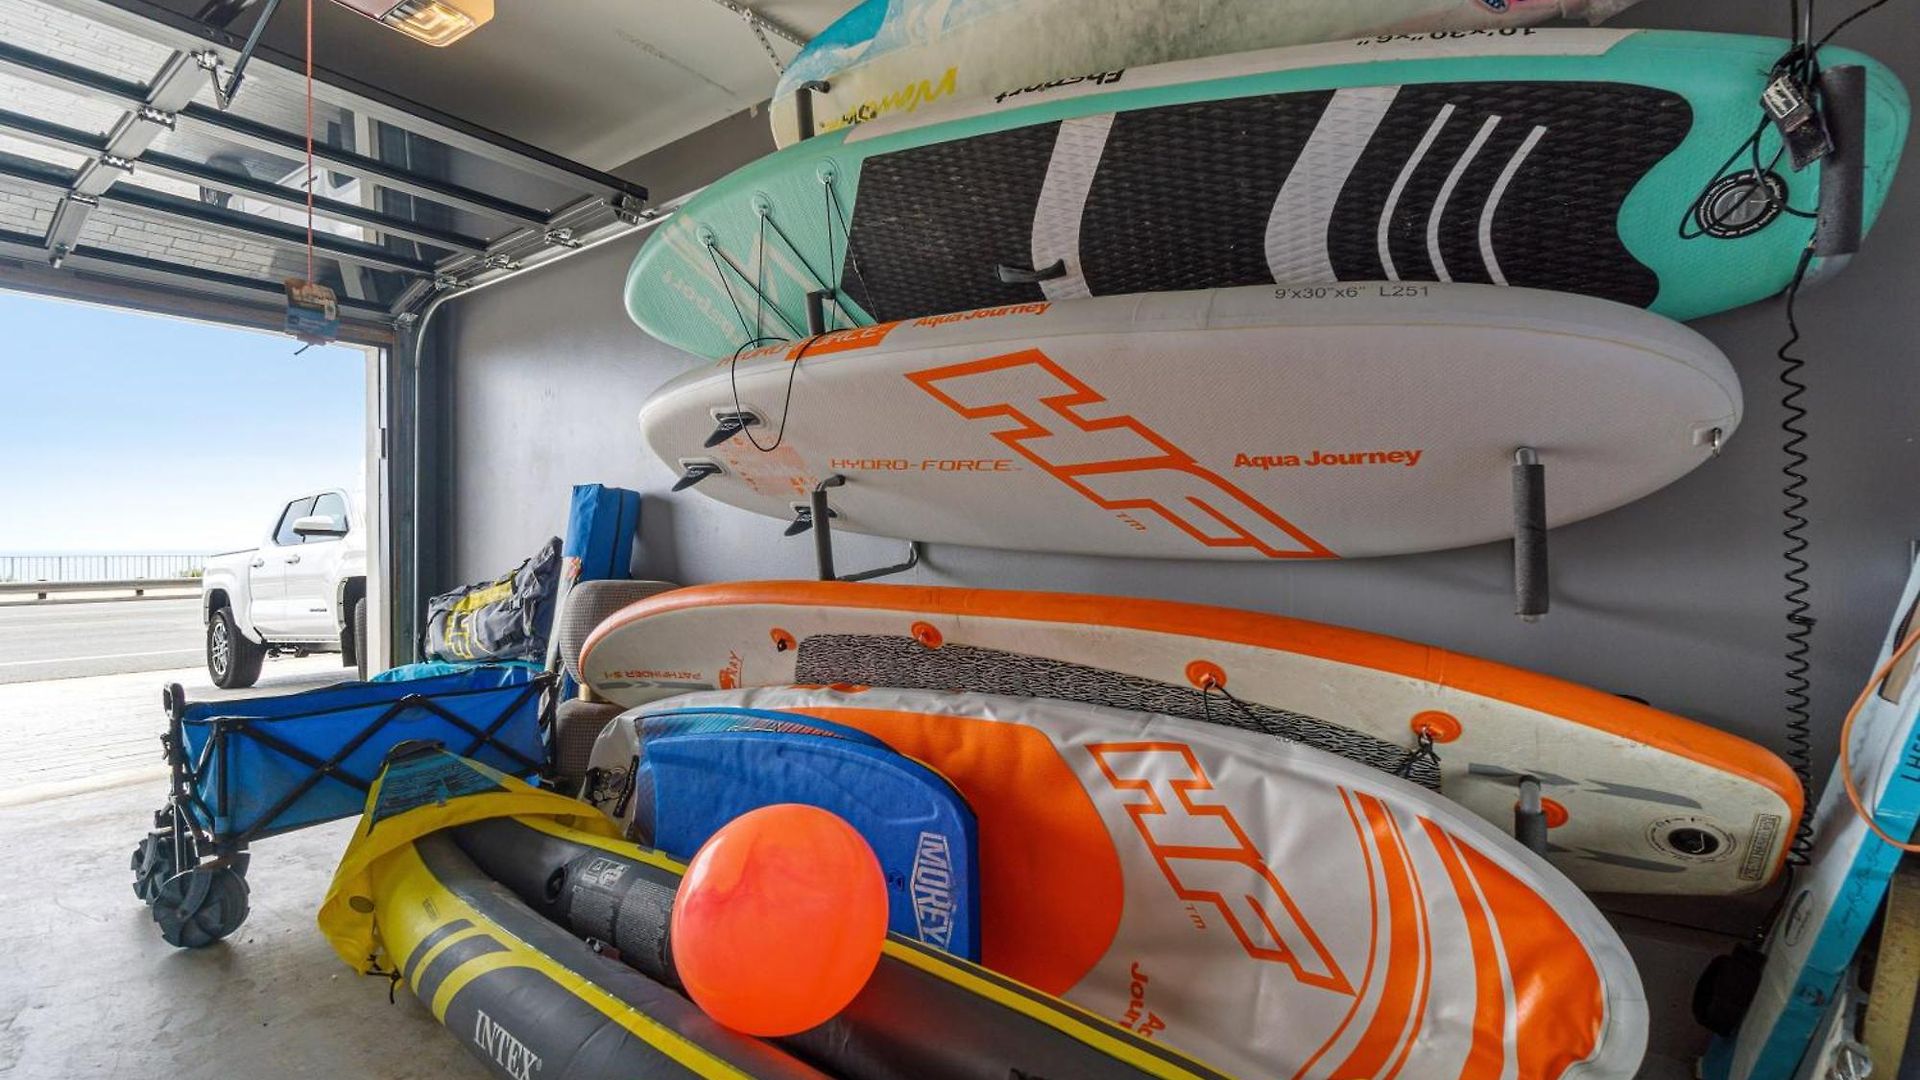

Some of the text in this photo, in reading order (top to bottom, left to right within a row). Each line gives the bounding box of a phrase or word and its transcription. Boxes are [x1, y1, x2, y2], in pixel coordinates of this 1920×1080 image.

[1379, 286, 1429, 297] L251
[965, 302, 1052, 320] Journey
[831, 459, 1014, 472] HYDRO-FORCE
[1235, 450, 1422, 470] Aqua Journey
[914, 840, 954, 949] MOREY
[474, 1009, 541, 1080] INTEX
